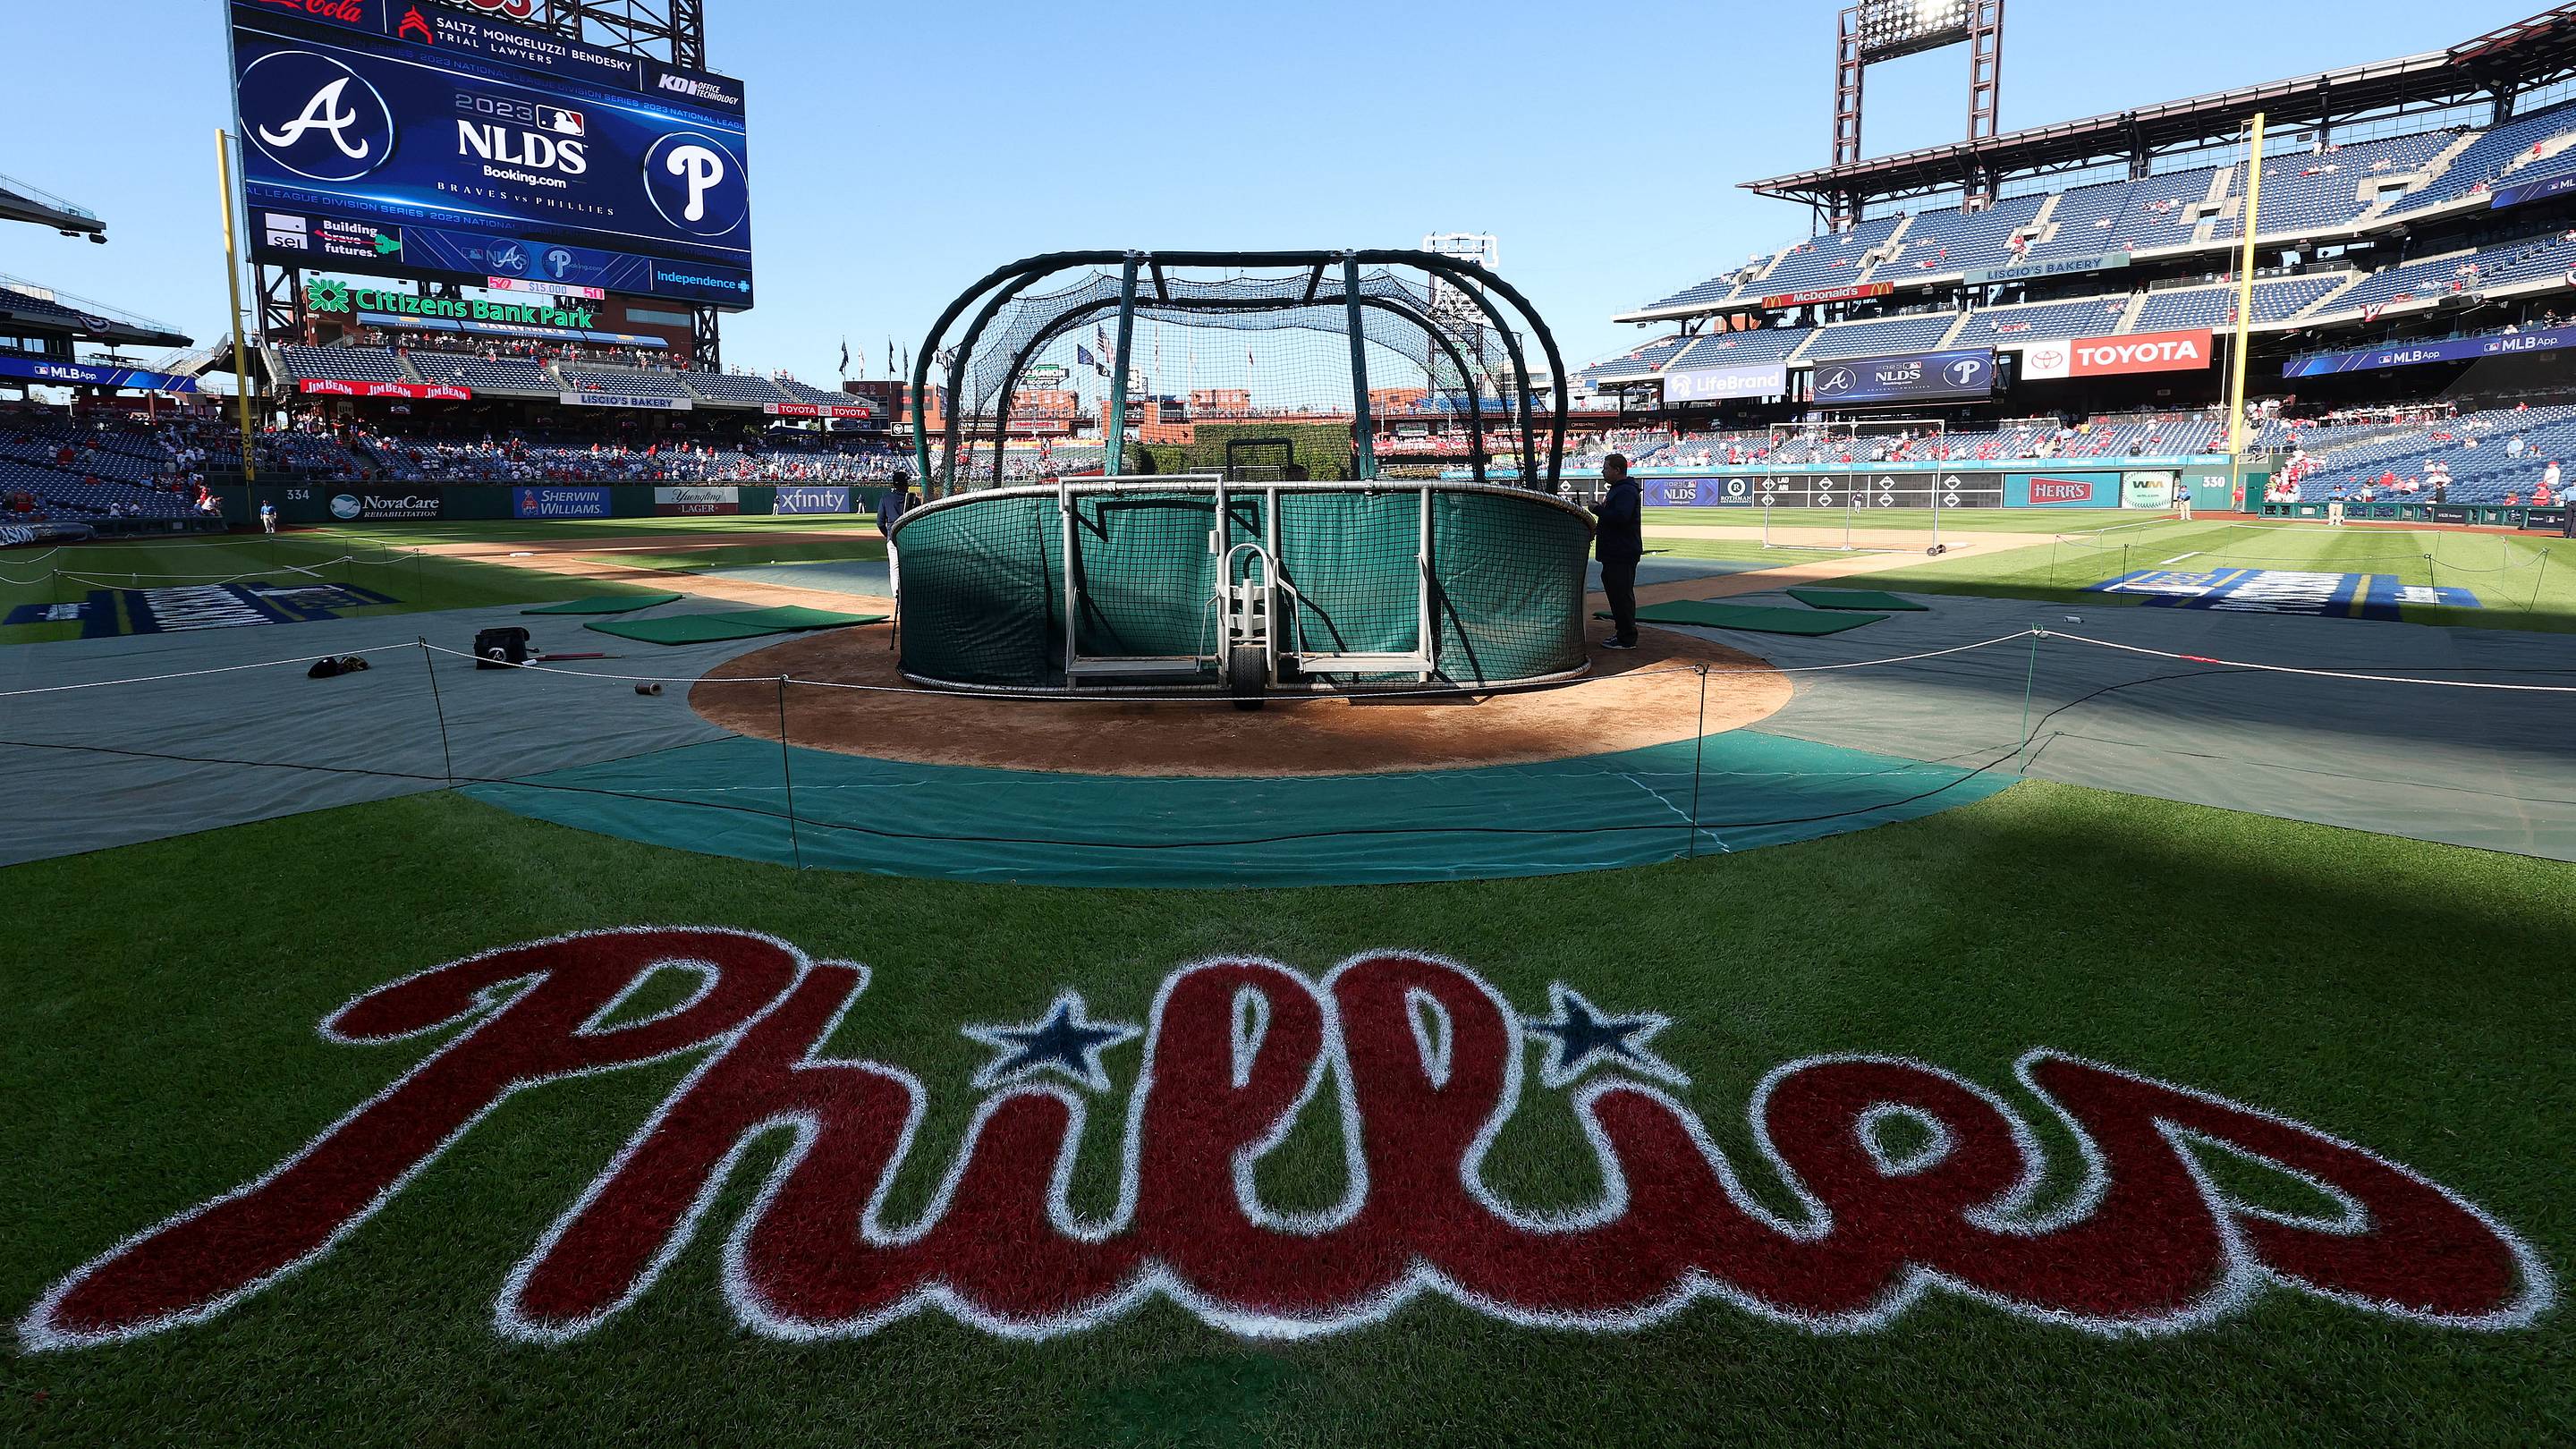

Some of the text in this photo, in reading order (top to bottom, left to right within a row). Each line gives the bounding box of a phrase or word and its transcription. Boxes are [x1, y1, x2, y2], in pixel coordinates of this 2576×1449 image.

[436, 17, 632, 72] SALTZ MONGELUZZI BENDESKY
[437, 31, 552, 64] TRIAL LAWYERS
[698, 81, 721, 94] OFFICE
[696, 89, 739, 106] TECHNOLOGY
[455, 94, 533, 121] 2023
[643, 102, 668, 114] 2023
[670, 108, 715, 124] NATIONAL
[259, 77, 369, 159] A
[457, 119, 588, 174] NLDS
[484, 165, 567, 189] Booking.com
[666, 145, 724, 221] P
[265, 189, 318, 204] LEAGUE
[322, 197, 377, 212] DIVISION
[380, 206, 424, 218] SERIES
[429, 213, 461, 223] 2023
[437, 182, 507, 199] BRAVES
[536, 197, 614, 216] PHILLIES
[324, 220, 377, 238] Building
[325, 243, 377, 258] futures.
[1987, 258, 2103, 279] LISCIO'S BAKERY
[657, 270, 736, 289] Independence
[1792, 286, 1859, 302] McDonald's
[355, 288, 595, 331] Citizens Bank Park
[2502, 336, 2558, 352] MLB App
[2076, 340, 2199, 367] TOYOTA
[2393, 351, 2440, 364] MLB App
[51, 366, 80, 379] MLB
[1876, 369, 1921, 382] NLDS
[1953, 360, 1980, 385] P
[306, 379, 352, 394] JIM BEAM
[1697, 371, 1779, 392] LifeBrand
[367, 384, 411, 398] JIM BEAM
[424, 386, 467, 401] JIM BEAM
[581, 394, 673, 408] LISCIO'S BAKERY
[780, 404, 868, 417] TOYOTA TOYOTA
[2132, 480, 2165, 488] WM
[2202, 476, 2225, 487] 330
[287, 489, 309, 500] 334
[541, 490, 599, 503] SHERWIN
[672, 488, 722, 502] Yuengling
[1664, 488, 1697, 500] NLDS
[2034, 483, 2086, 497] HERR'S
[363, 495, 439, 511] NovaCare
[681, 504, 716, 513] LAGER
[781, 489, 846, 513] xfinity
[364, 510, 436, 518] REHABILITATION
[18, 924, 2558, 1351] Phillies
